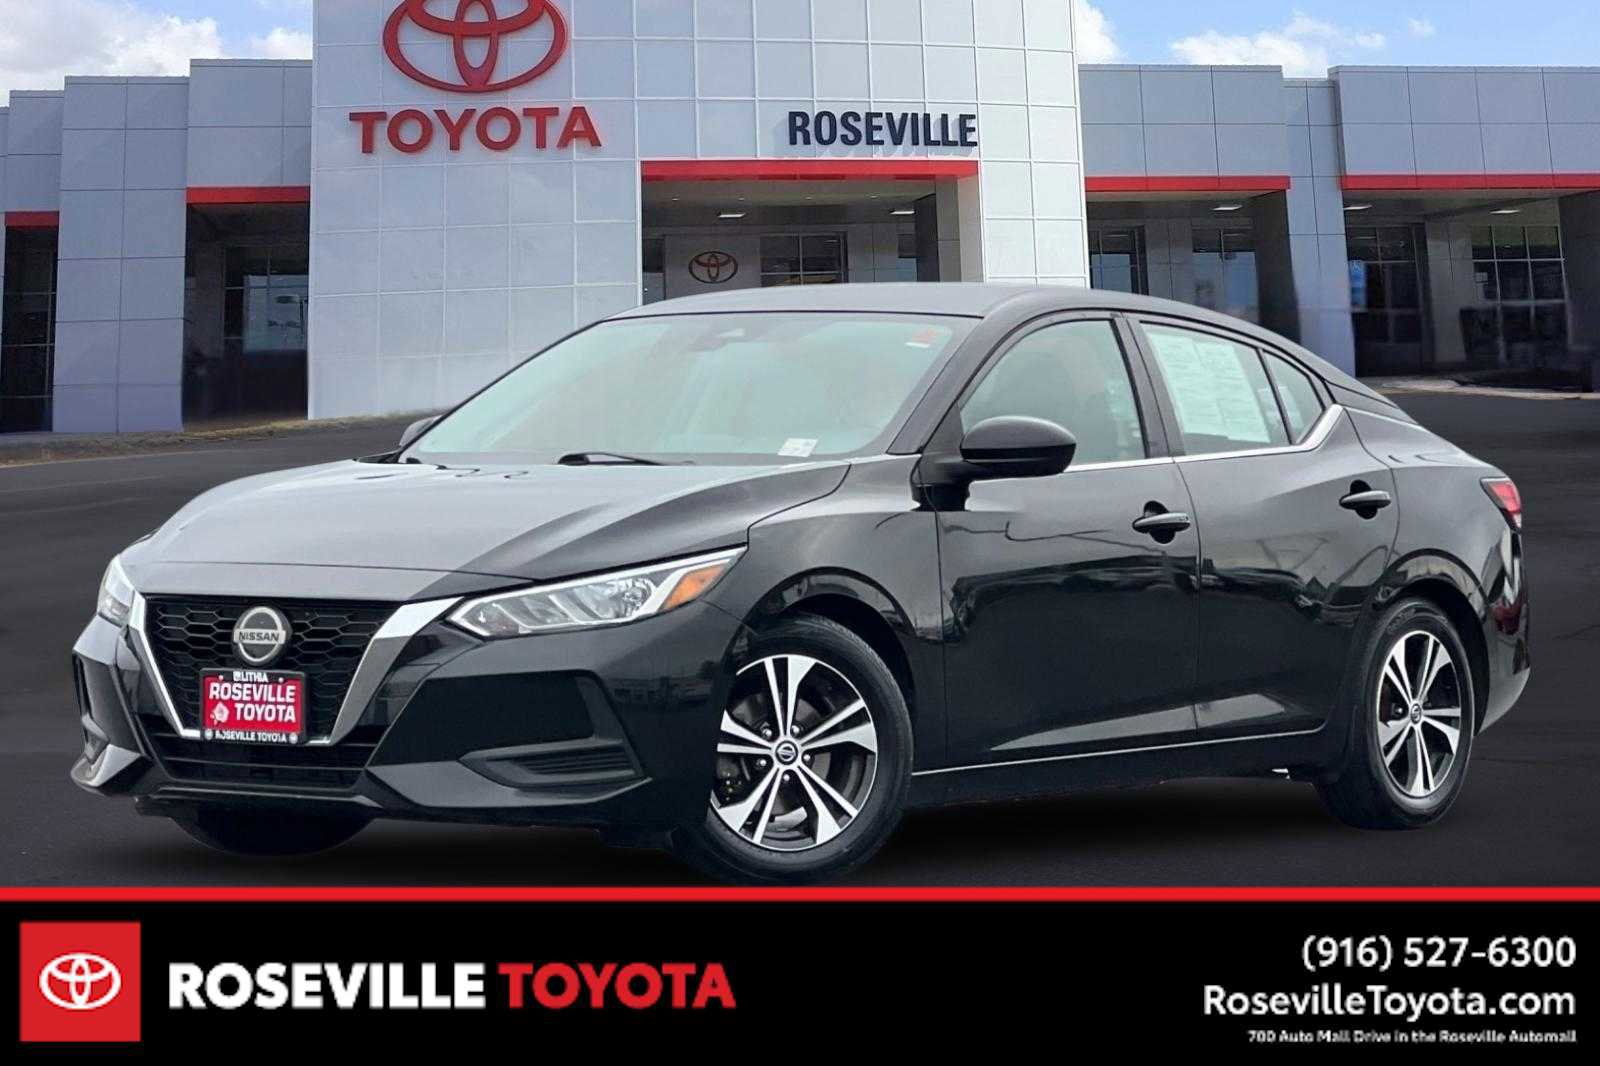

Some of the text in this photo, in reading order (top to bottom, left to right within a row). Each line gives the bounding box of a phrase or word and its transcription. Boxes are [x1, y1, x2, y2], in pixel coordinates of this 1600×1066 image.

[349, 106, 602, 154] TOYOTA
[788, 110, 978, 147] ROSEVILLE
[239, 631, 279, 641] NISSAN
[209, 682, 297, 703] ROSEVILLE
[234, 702, 296, 723] TOYOTA
[215, 730, 287, 743] ROSEVILLE TOYOTA
